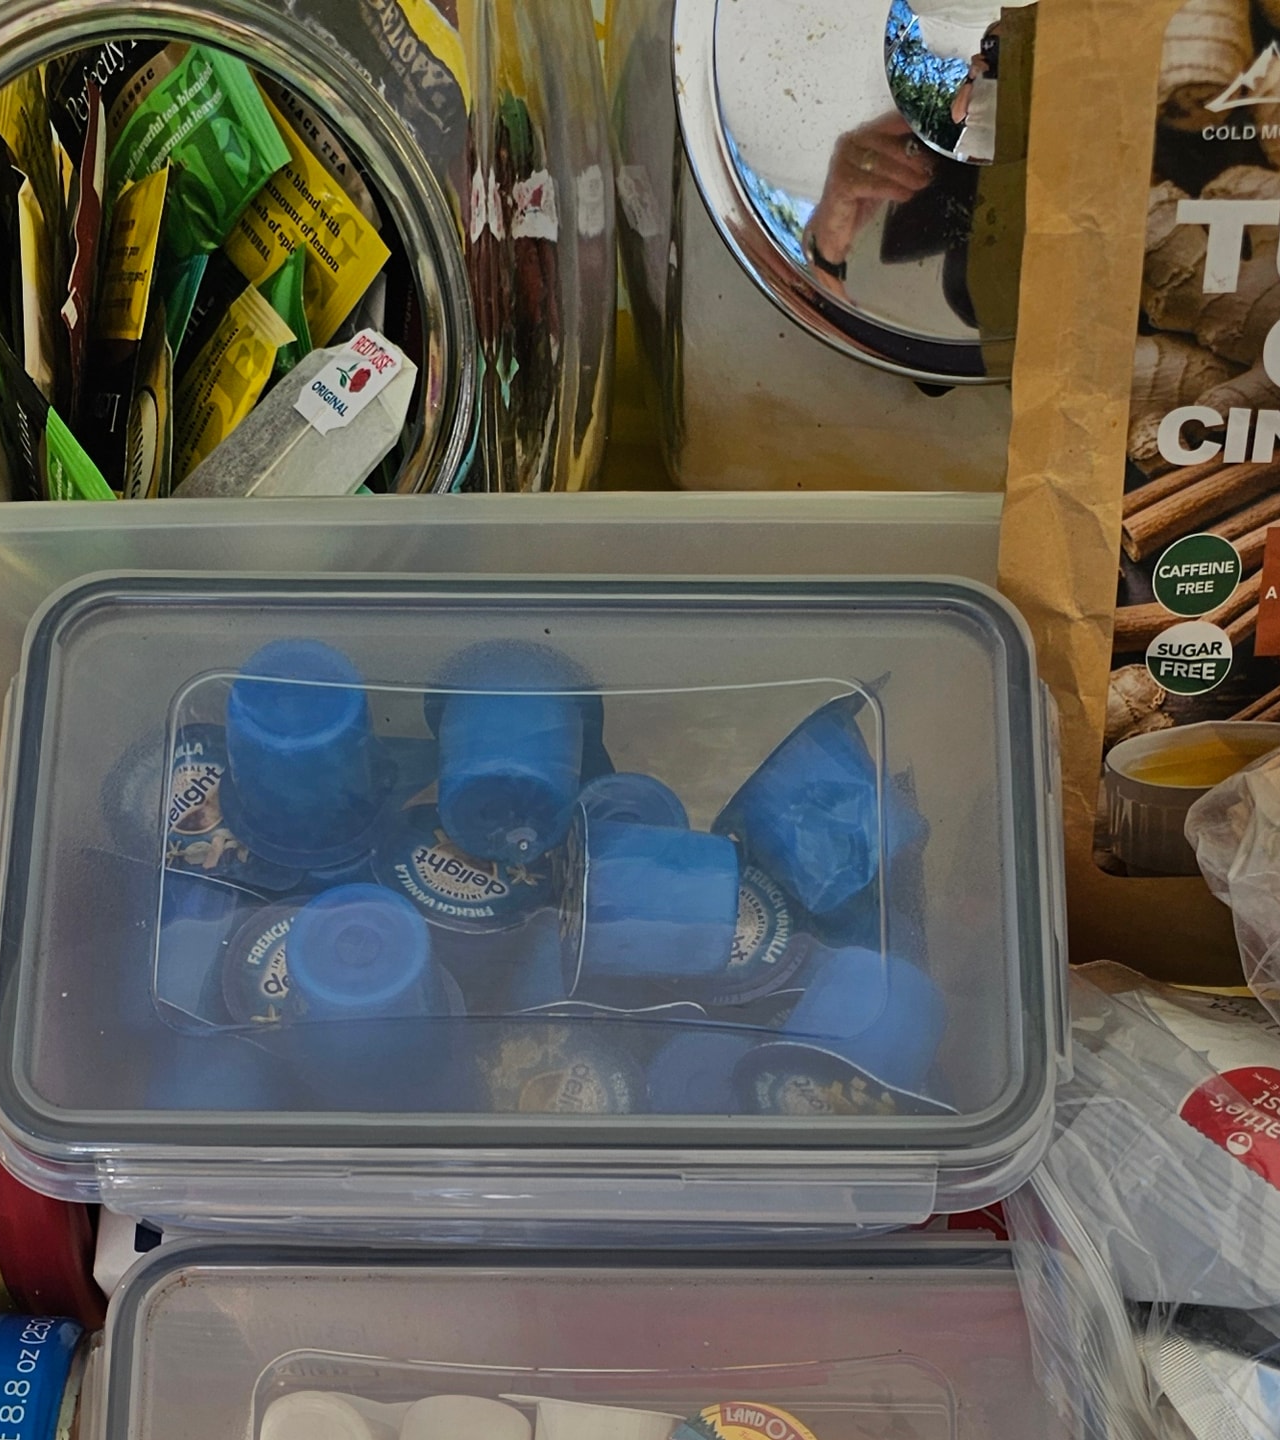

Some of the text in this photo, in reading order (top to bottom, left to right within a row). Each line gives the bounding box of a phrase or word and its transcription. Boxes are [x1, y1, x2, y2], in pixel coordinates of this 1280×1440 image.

[279, 88, 348, 177] BLACK TEA
[1201, 124, 1255, 142] COLD
[291, 169, 342, 238] blend with
[238, 217, 273, 264] NATURAL
[310, 380, 350, 418] ORIGINAL
[1159, 560, 1235, 579] CAFFEINE
[1176, 581, 1214, 596] FREE
[1266, 586, 1277, 599] A
[1156, 641, 1223, 658] SUGAR
[1159, 661, 1216, 681] FREE
[415, 848, 507, 897] delight
[247, 919, 291, 966] FRENCH
